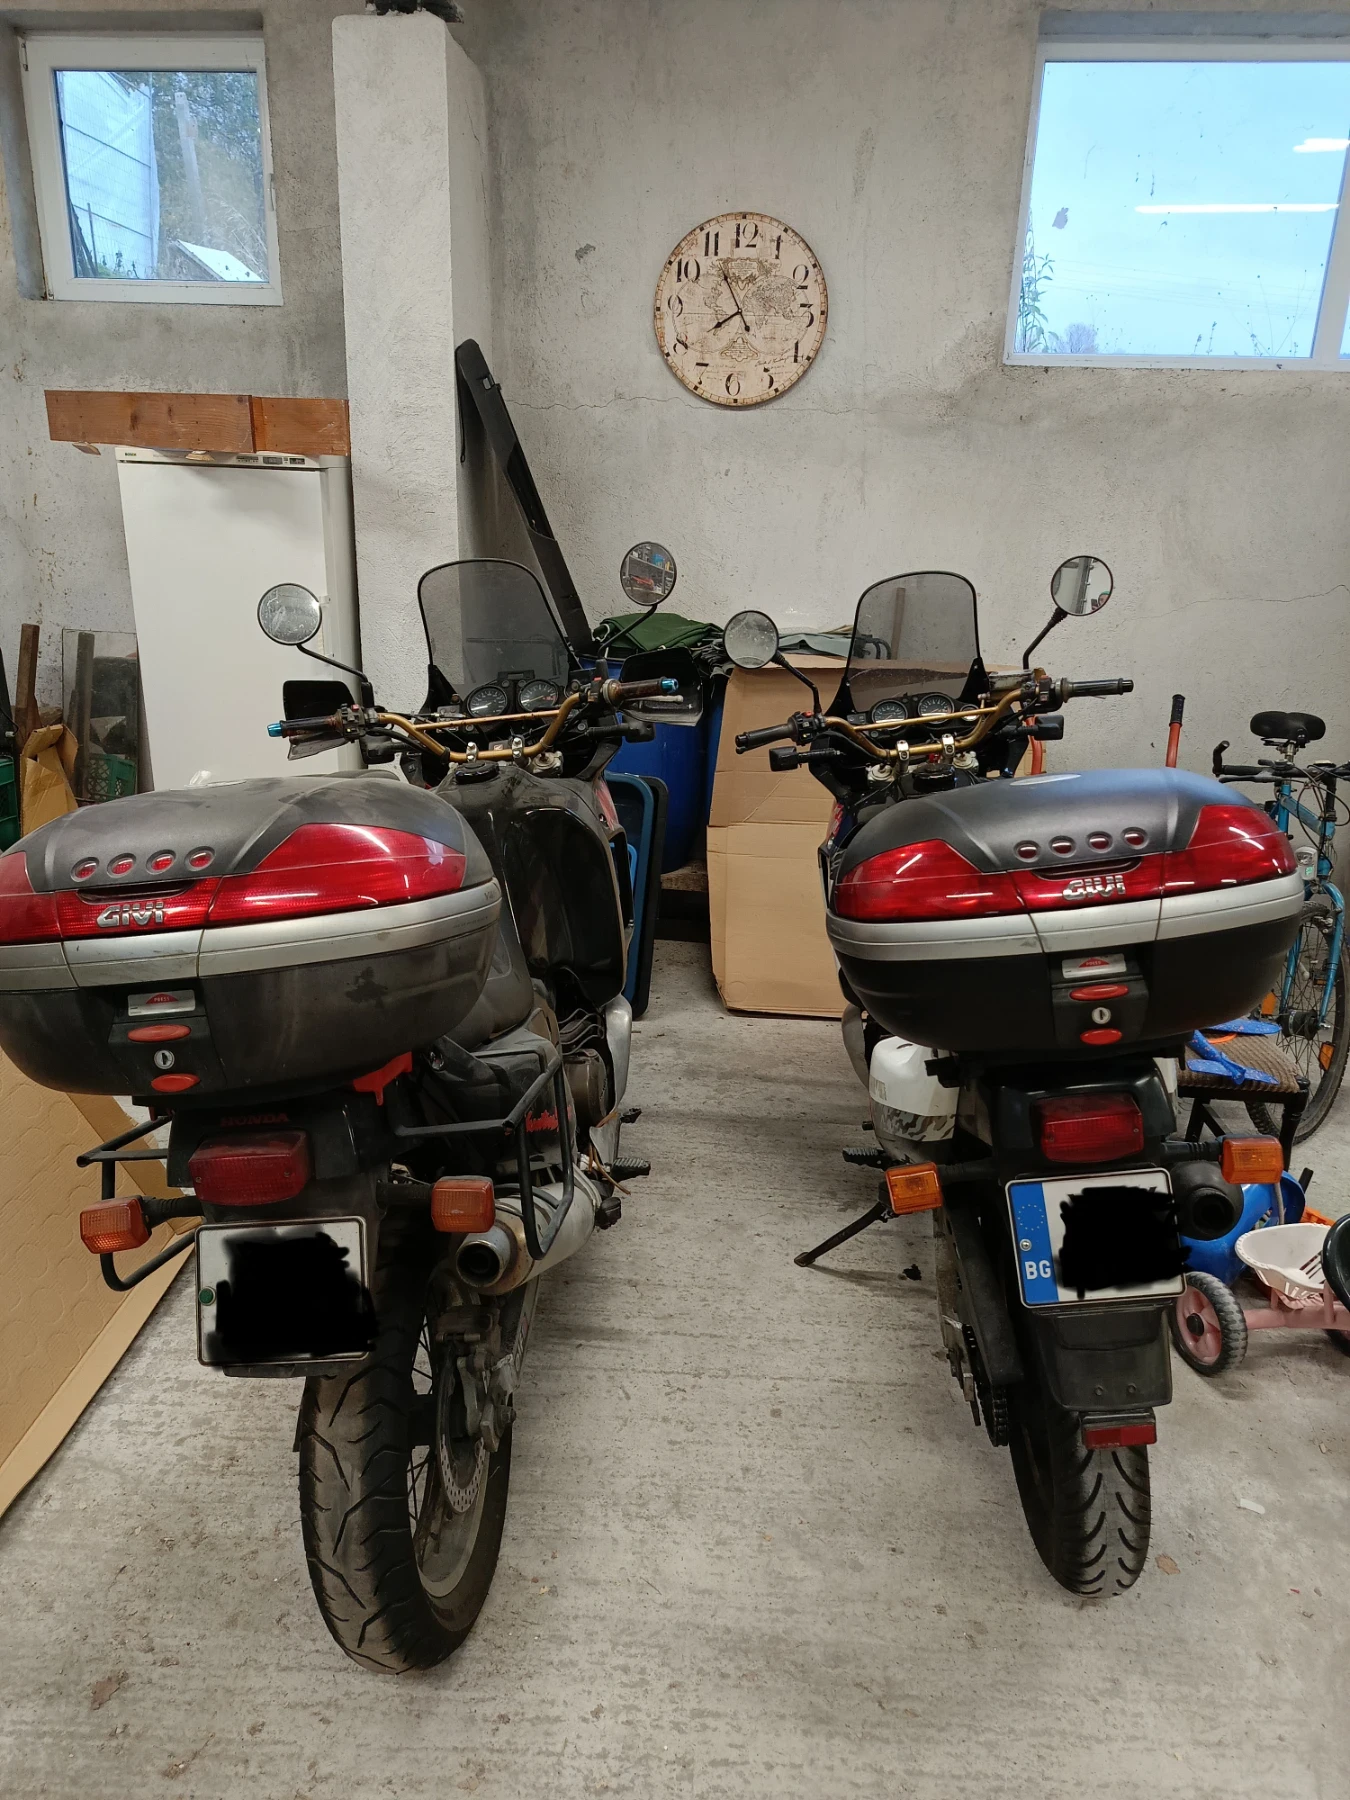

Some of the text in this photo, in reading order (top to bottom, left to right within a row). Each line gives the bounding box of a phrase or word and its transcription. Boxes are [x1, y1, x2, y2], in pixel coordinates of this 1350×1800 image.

[704, 231, 720, 257] 11
[735, 222, 759, 249] 12
[774, 234, 782, 260] 1
[676, 257, 701, 283] 10
[792, 263, 809, 290] 2
[667, 294, 684, 318] 9
[798, 302, 815, 328] 3
[672, 333, 689, 355] 8
[695, 361, 710, 386] 7
[725, 372, 741, 396] 6
[1062, 875, 1126, 901] GIVI
[96, 901, 165, 928] GIVI
[220, 1112, 289, 1127] HONDA
[1025, 1260, 1051, 1280] BG
